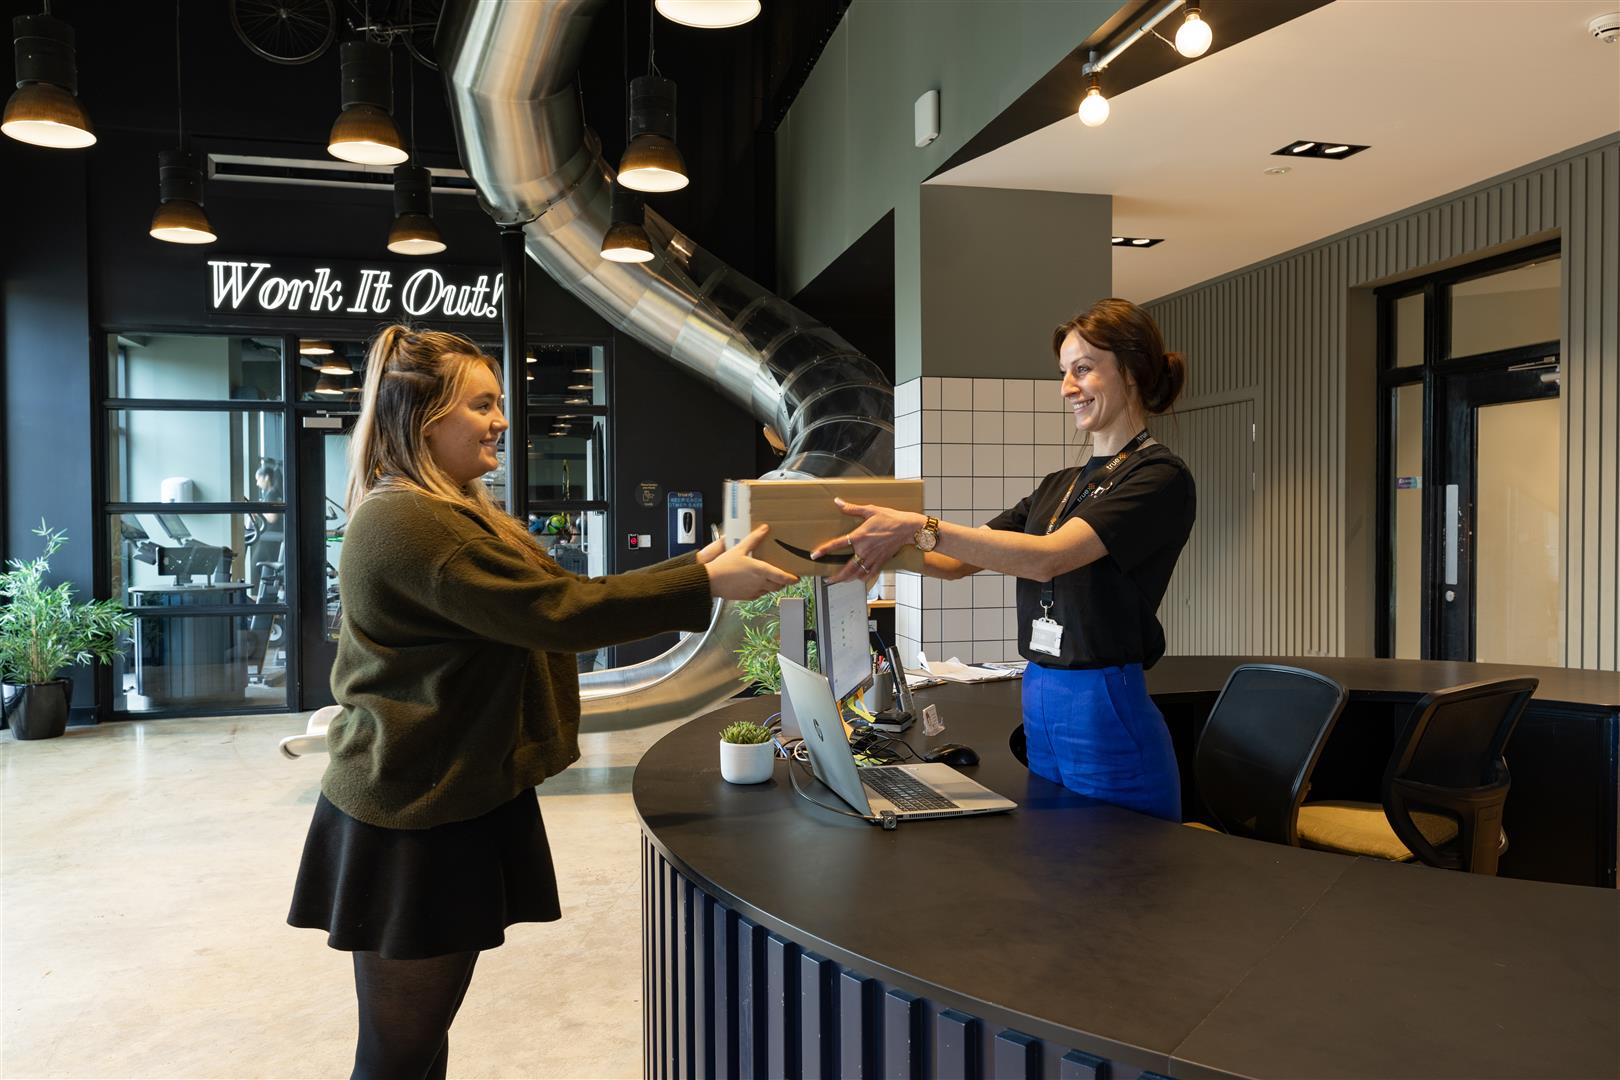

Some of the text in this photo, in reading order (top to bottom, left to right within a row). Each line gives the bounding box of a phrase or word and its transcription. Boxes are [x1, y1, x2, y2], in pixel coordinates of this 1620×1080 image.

[207, 260, 504, 319] Work It Out!
